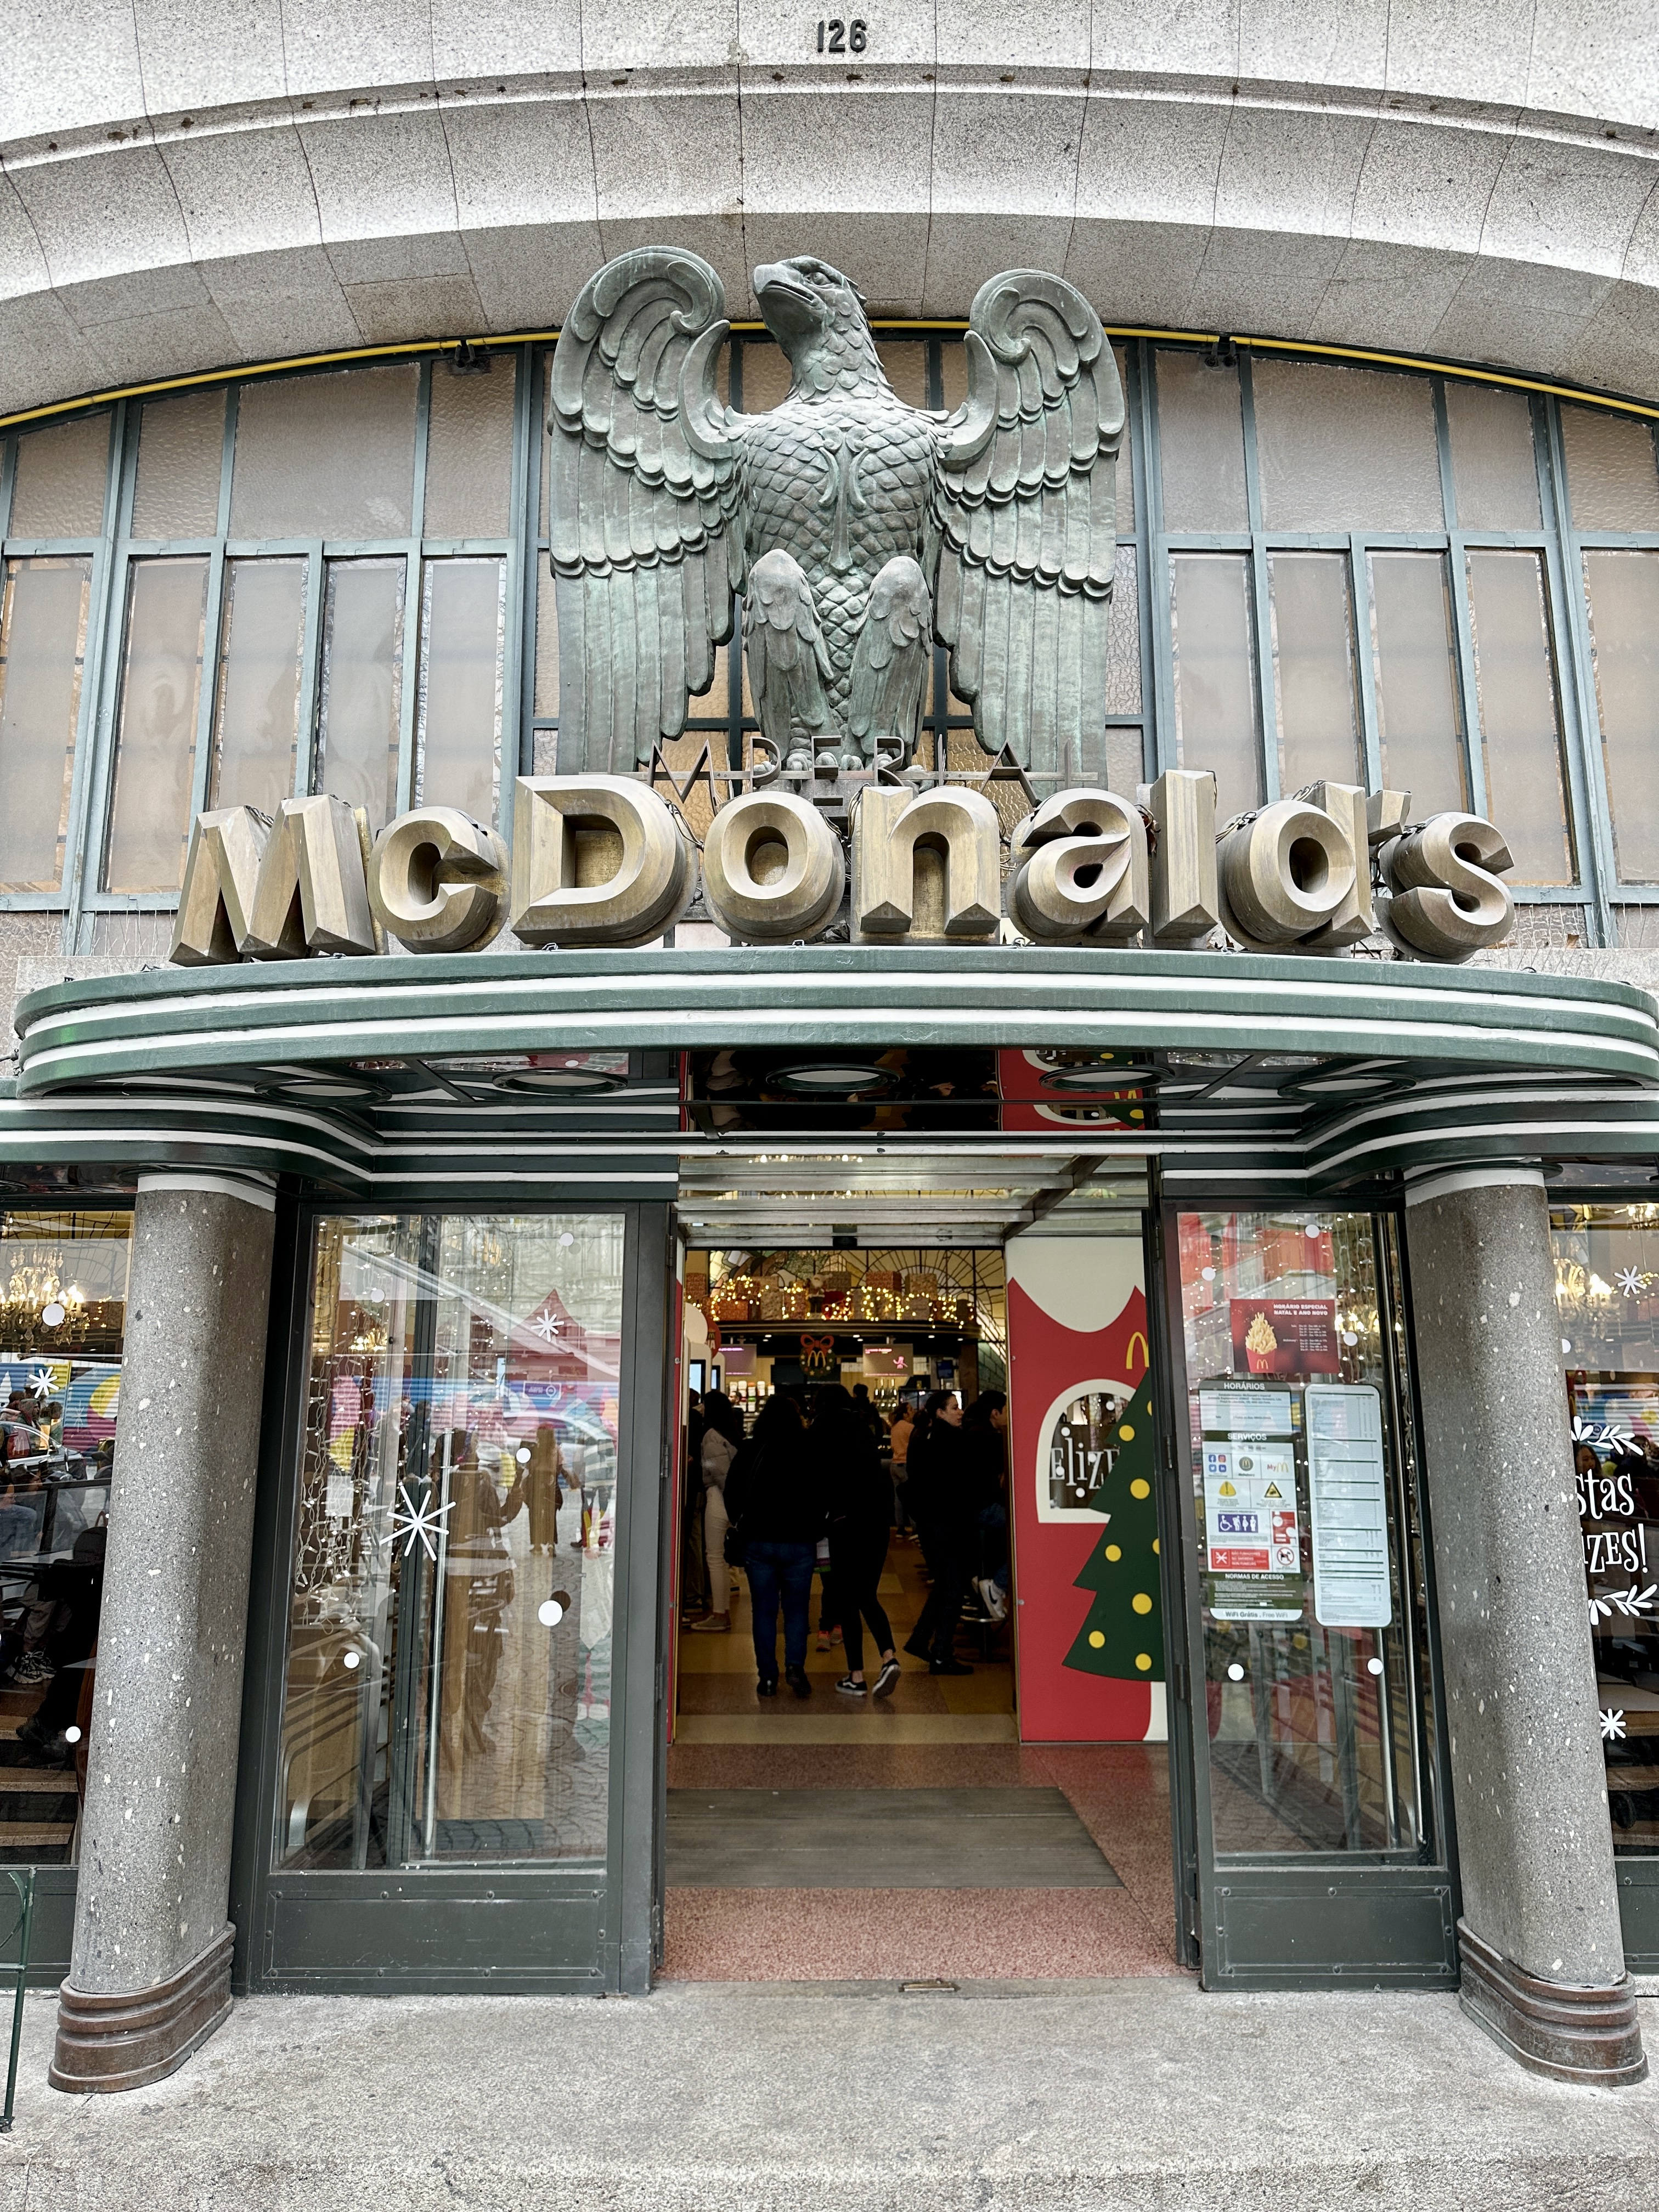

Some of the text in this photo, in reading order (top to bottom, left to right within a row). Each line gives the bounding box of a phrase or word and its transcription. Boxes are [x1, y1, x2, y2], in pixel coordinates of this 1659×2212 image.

[818, 19, 866, 52] 126
[169, 769, 1515, 967] McDonald's
[1223, 1381, 1265, 1390] HORÁRIOS
[1227, 1433, 1267, 1442] SERVIÇOS
